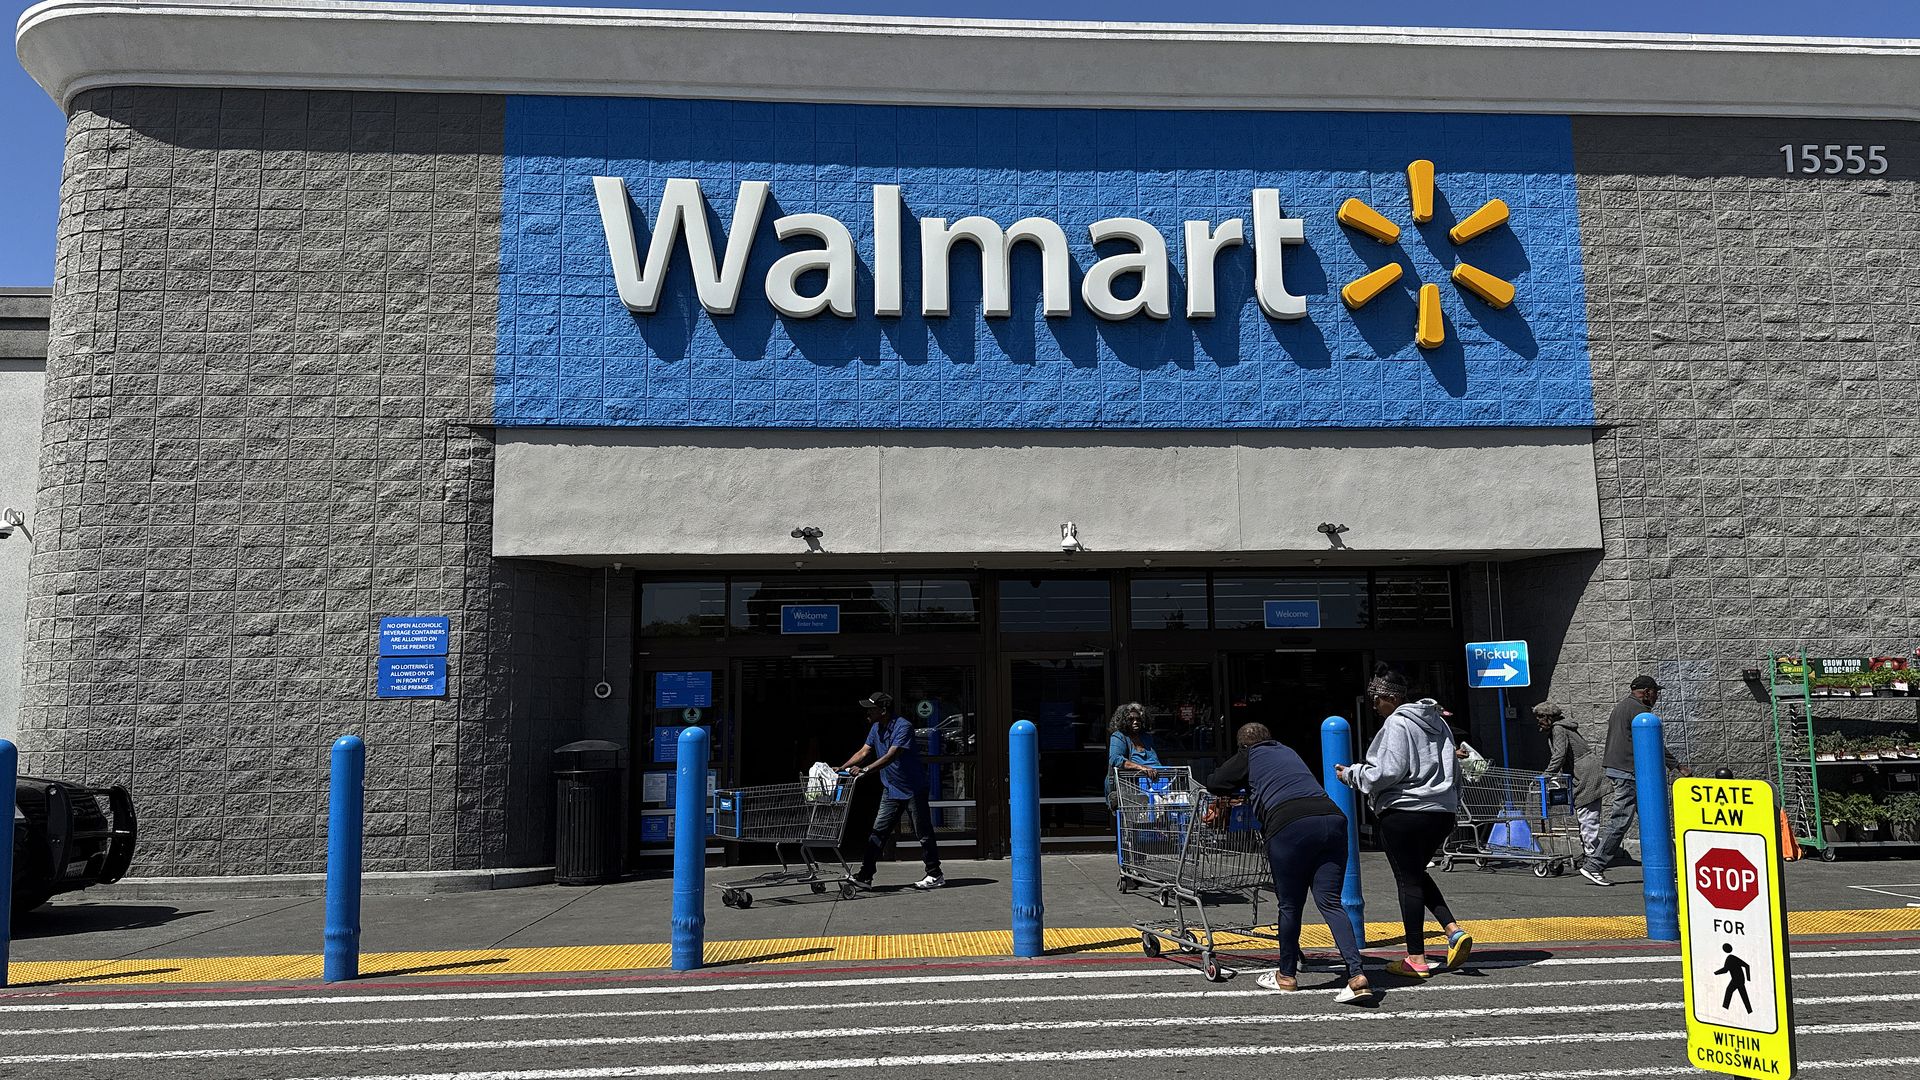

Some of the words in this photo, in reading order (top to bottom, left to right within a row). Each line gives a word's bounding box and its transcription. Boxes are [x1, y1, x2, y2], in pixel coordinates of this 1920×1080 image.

[1779, 144, 1888, 175] 15555
[592, 176, 1306, 321] Walmart
[793, 612, 828, 620] Welcome
[1275, 610, 1309, 618] Welcome
[1475, 648, 1519, 662] Pickup
[1822, 659, 1843, 667] GROW
[1844, 659, 1861, 667] YOUR
[1824, 666, 1860, 674] GROCERIES
[1690, 785, 1754, 805] STATE
[1701, 807, 1744, 827] LAW
[1698, 865, 1756, 892] STOP
[1713, 919, 1745, 936] FOR
[1713, 1031, 1761, 1052] WITHIN
[1697, 1047, 1780, 1074] CROSSWALK
